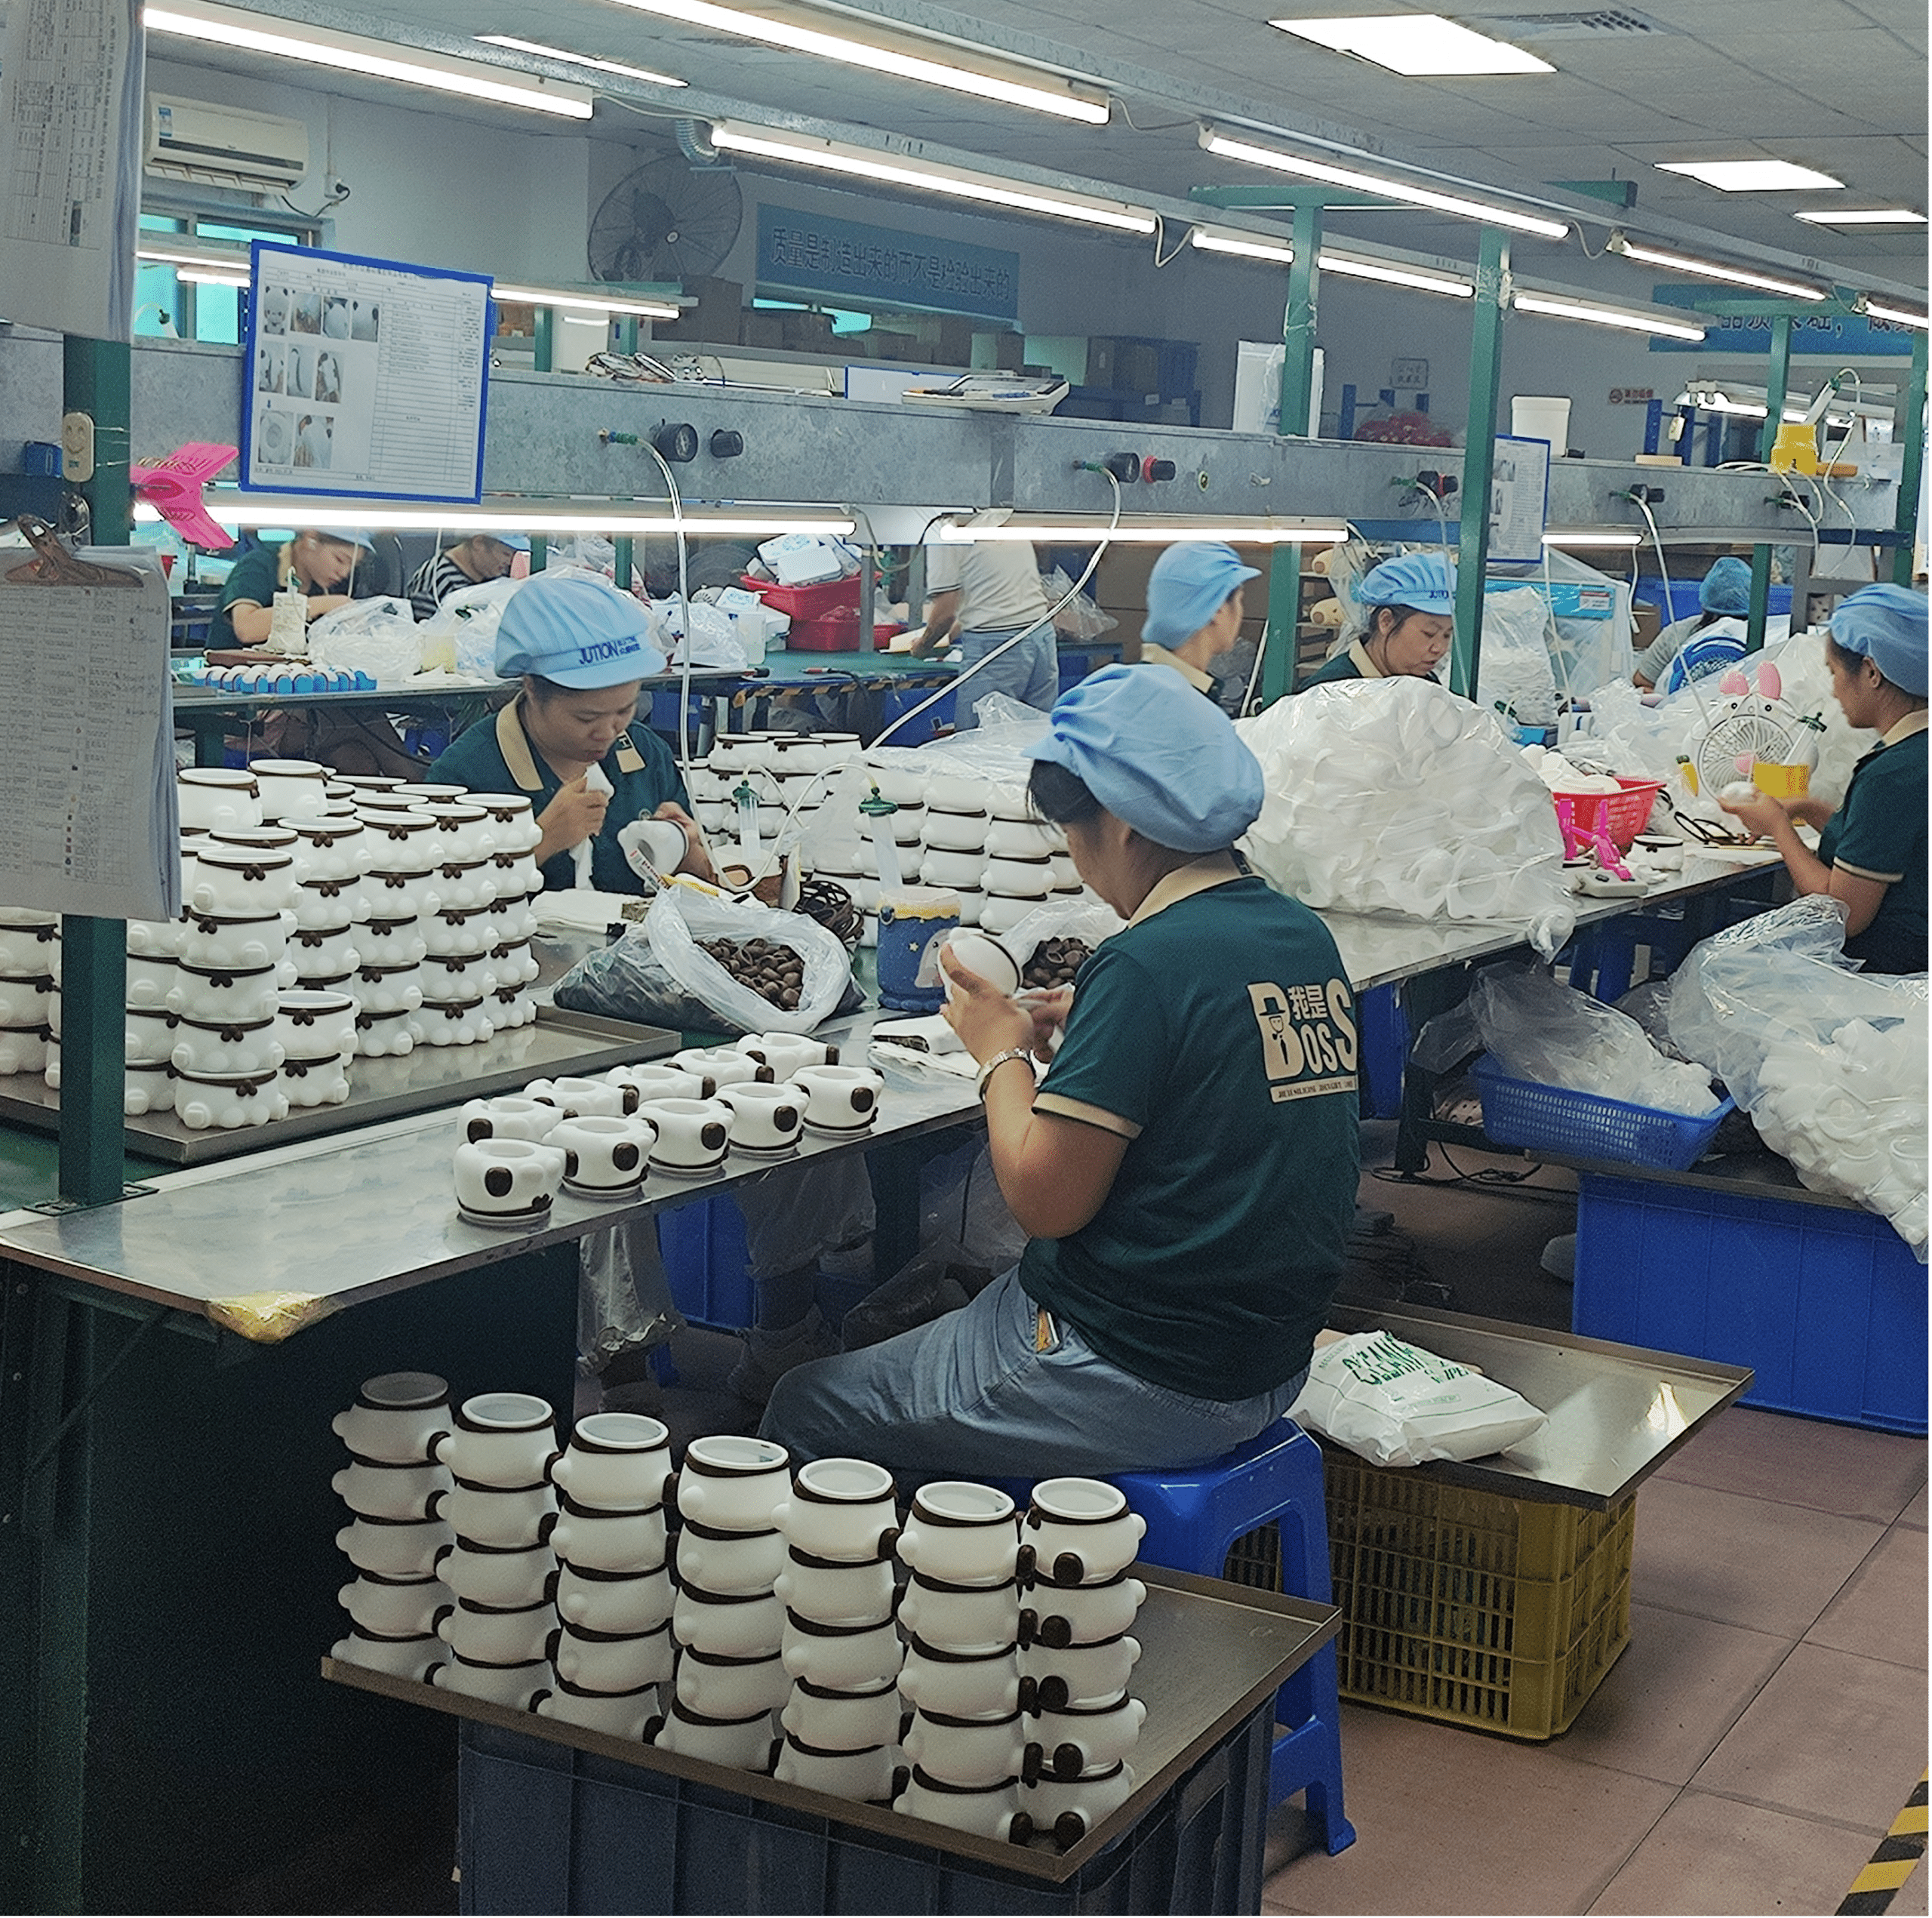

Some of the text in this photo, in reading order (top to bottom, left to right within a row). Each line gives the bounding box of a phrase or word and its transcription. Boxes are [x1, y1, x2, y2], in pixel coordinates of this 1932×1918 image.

[771, 227, 1010, 300] 质量是制造出来的而不是检验出来的
[1286, 984, 1328, 1021] 我是
